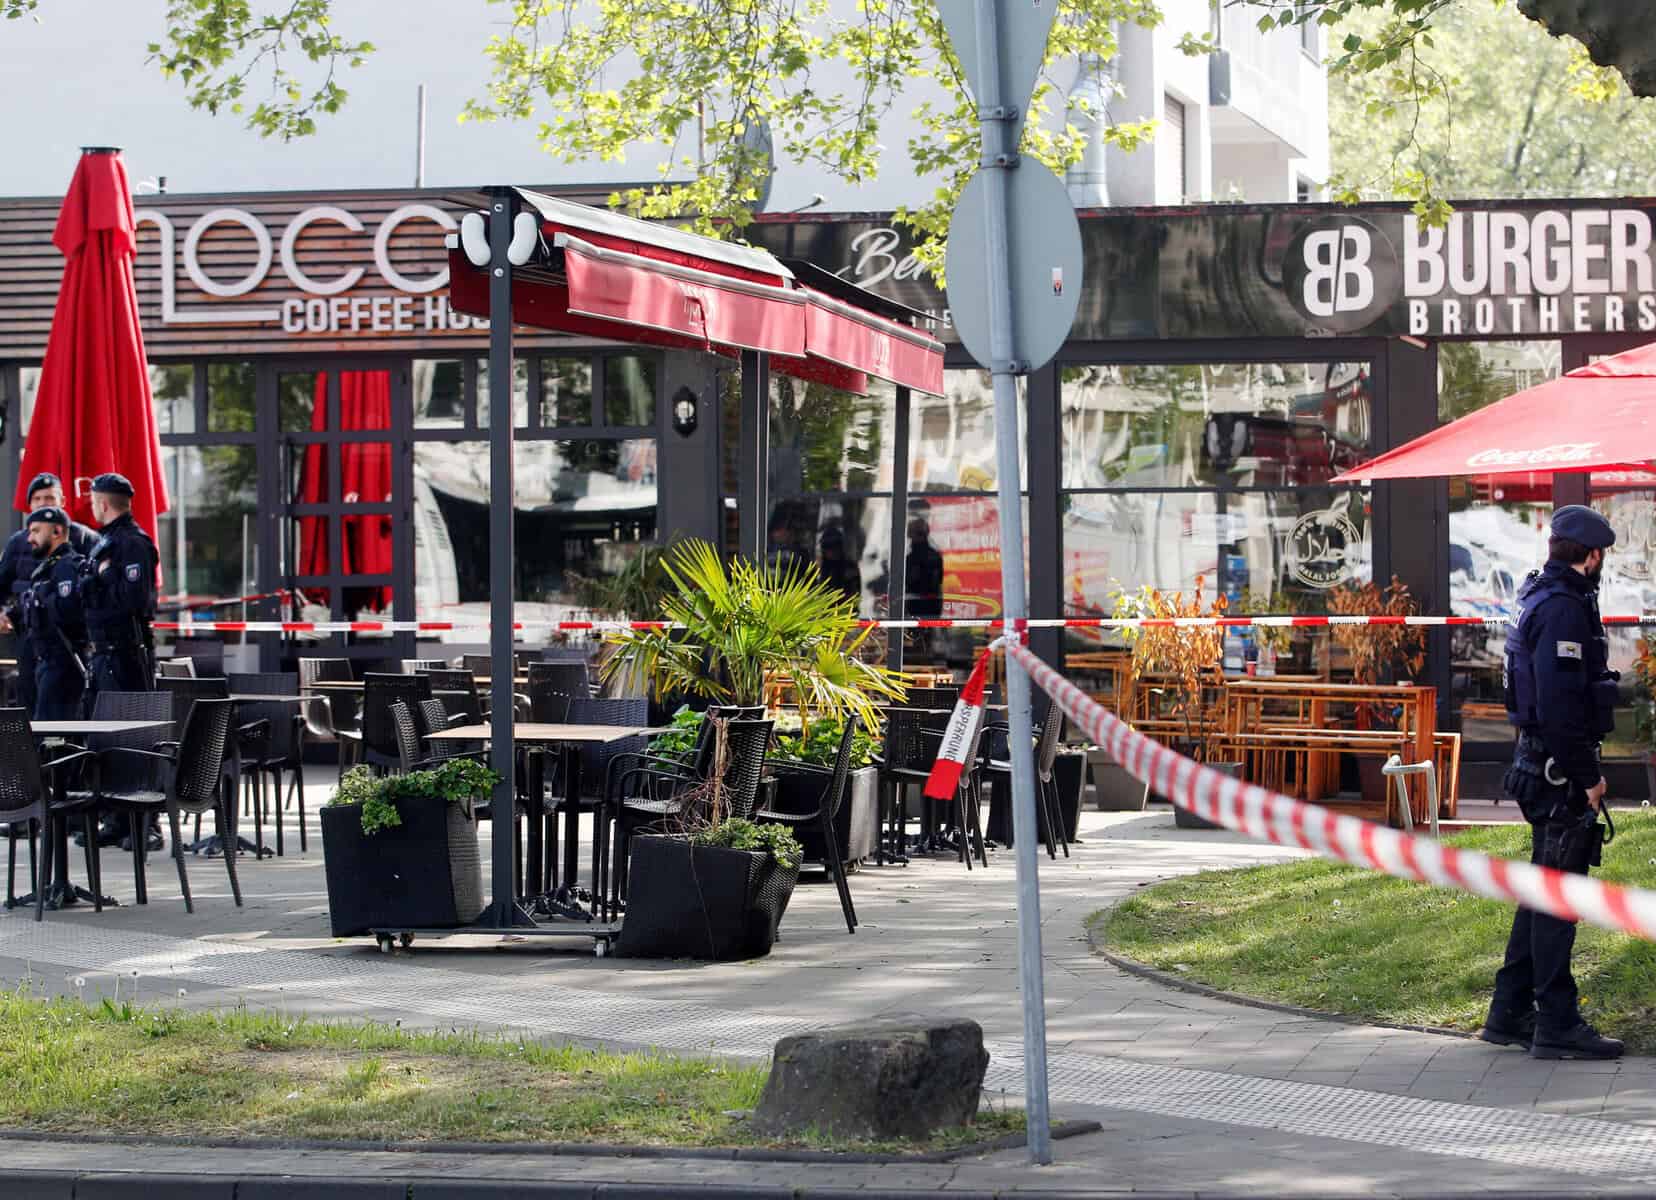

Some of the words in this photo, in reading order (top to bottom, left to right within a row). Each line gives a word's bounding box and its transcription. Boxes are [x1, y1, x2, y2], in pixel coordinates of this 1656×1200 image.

[1404, 208, 1655, 297] BURGER
[282, 296, 415, 333] COFFEE
[1409, 294, 1656, 336] BROTHERS
